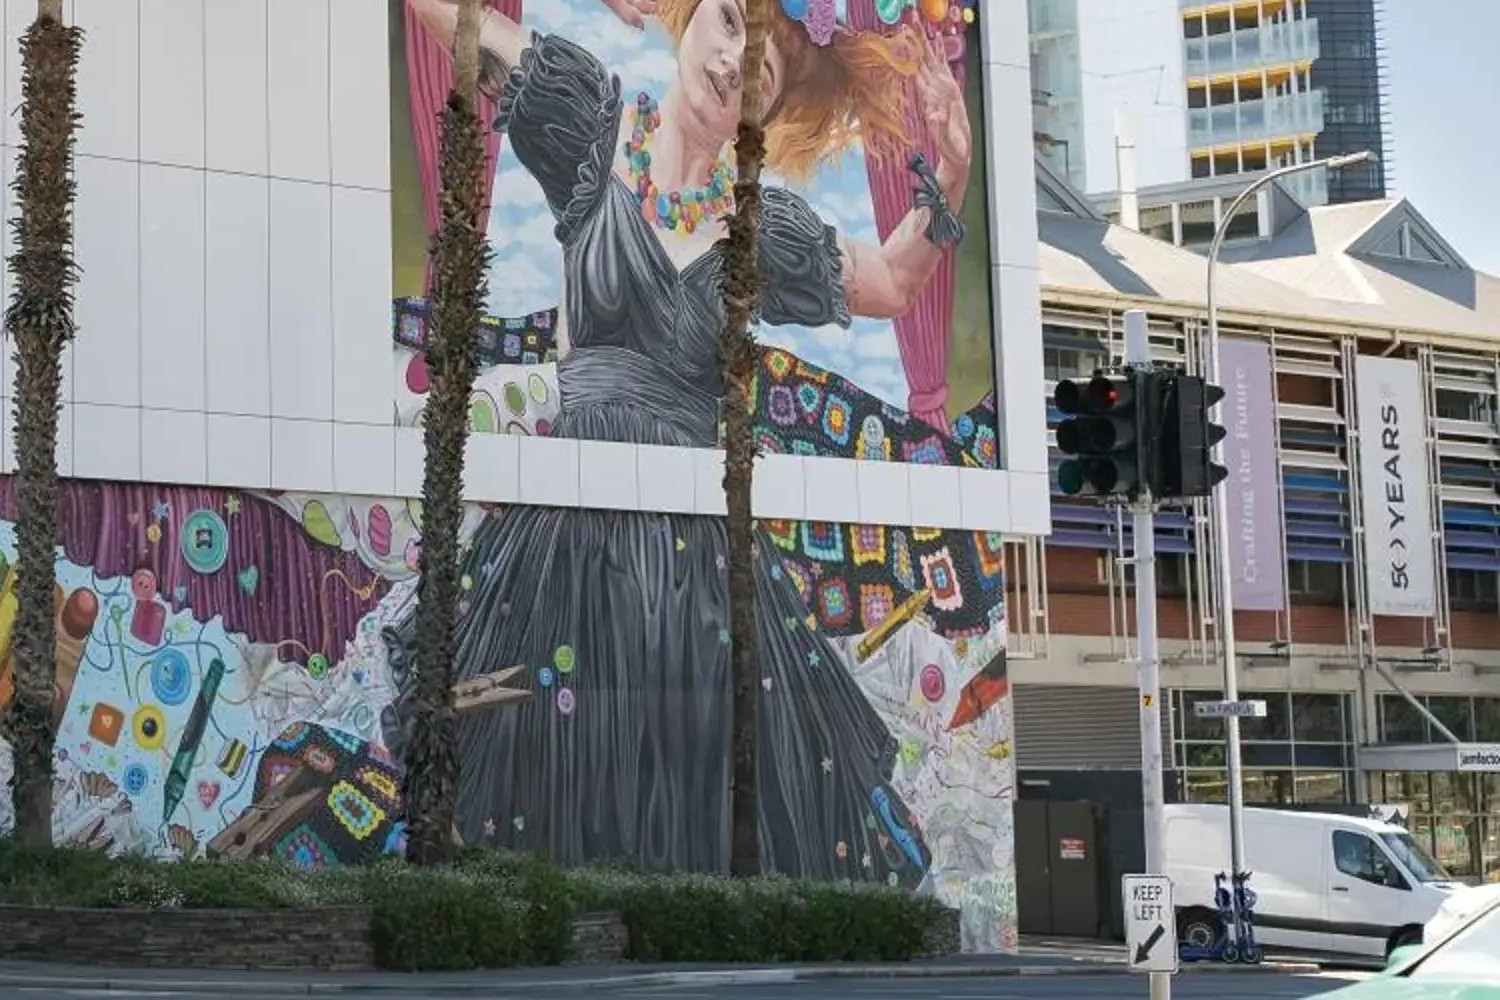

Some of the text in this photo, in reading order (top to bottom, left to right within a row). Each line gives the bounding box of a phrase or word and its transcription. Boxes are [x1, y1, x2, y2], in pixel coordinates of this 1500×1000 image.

[1381, 404, 1405, 530] YEARS
[1234, 367, 1257, 584] Crafting the Future
[1143, 695, 1152, 706] 7
[1133, 885, 1162, 901] KEEP
[1133, 904, 1162, 920] LEFT
